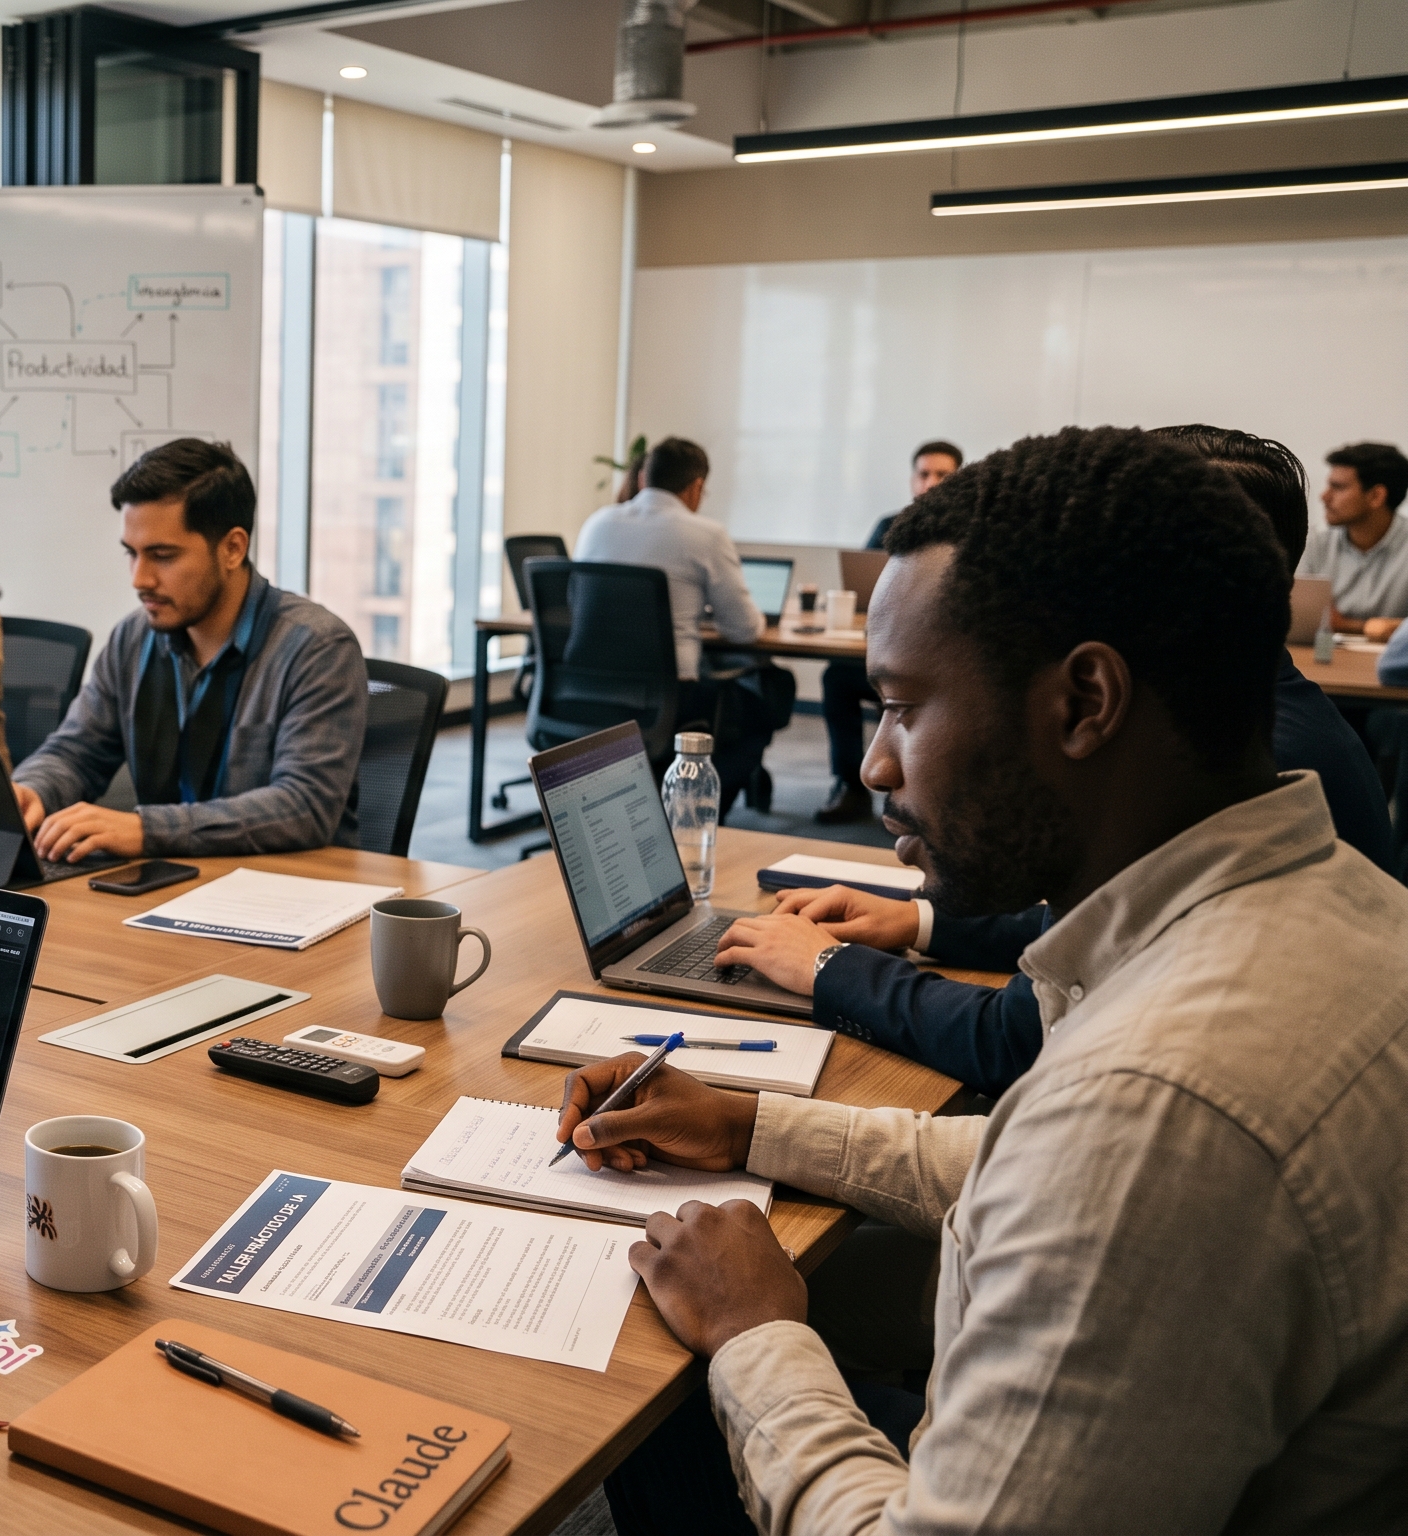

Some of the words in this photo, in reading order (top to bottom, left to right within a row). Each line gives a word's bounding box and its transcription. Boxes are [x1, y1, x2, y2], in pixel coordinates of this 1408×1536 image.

[6, 350, 130, 379] Productividad
[279, 1201, 299, 1217] DE
[292, 1192, 308, 1204] IA
[334, 1424, 468, 1532] Claude
